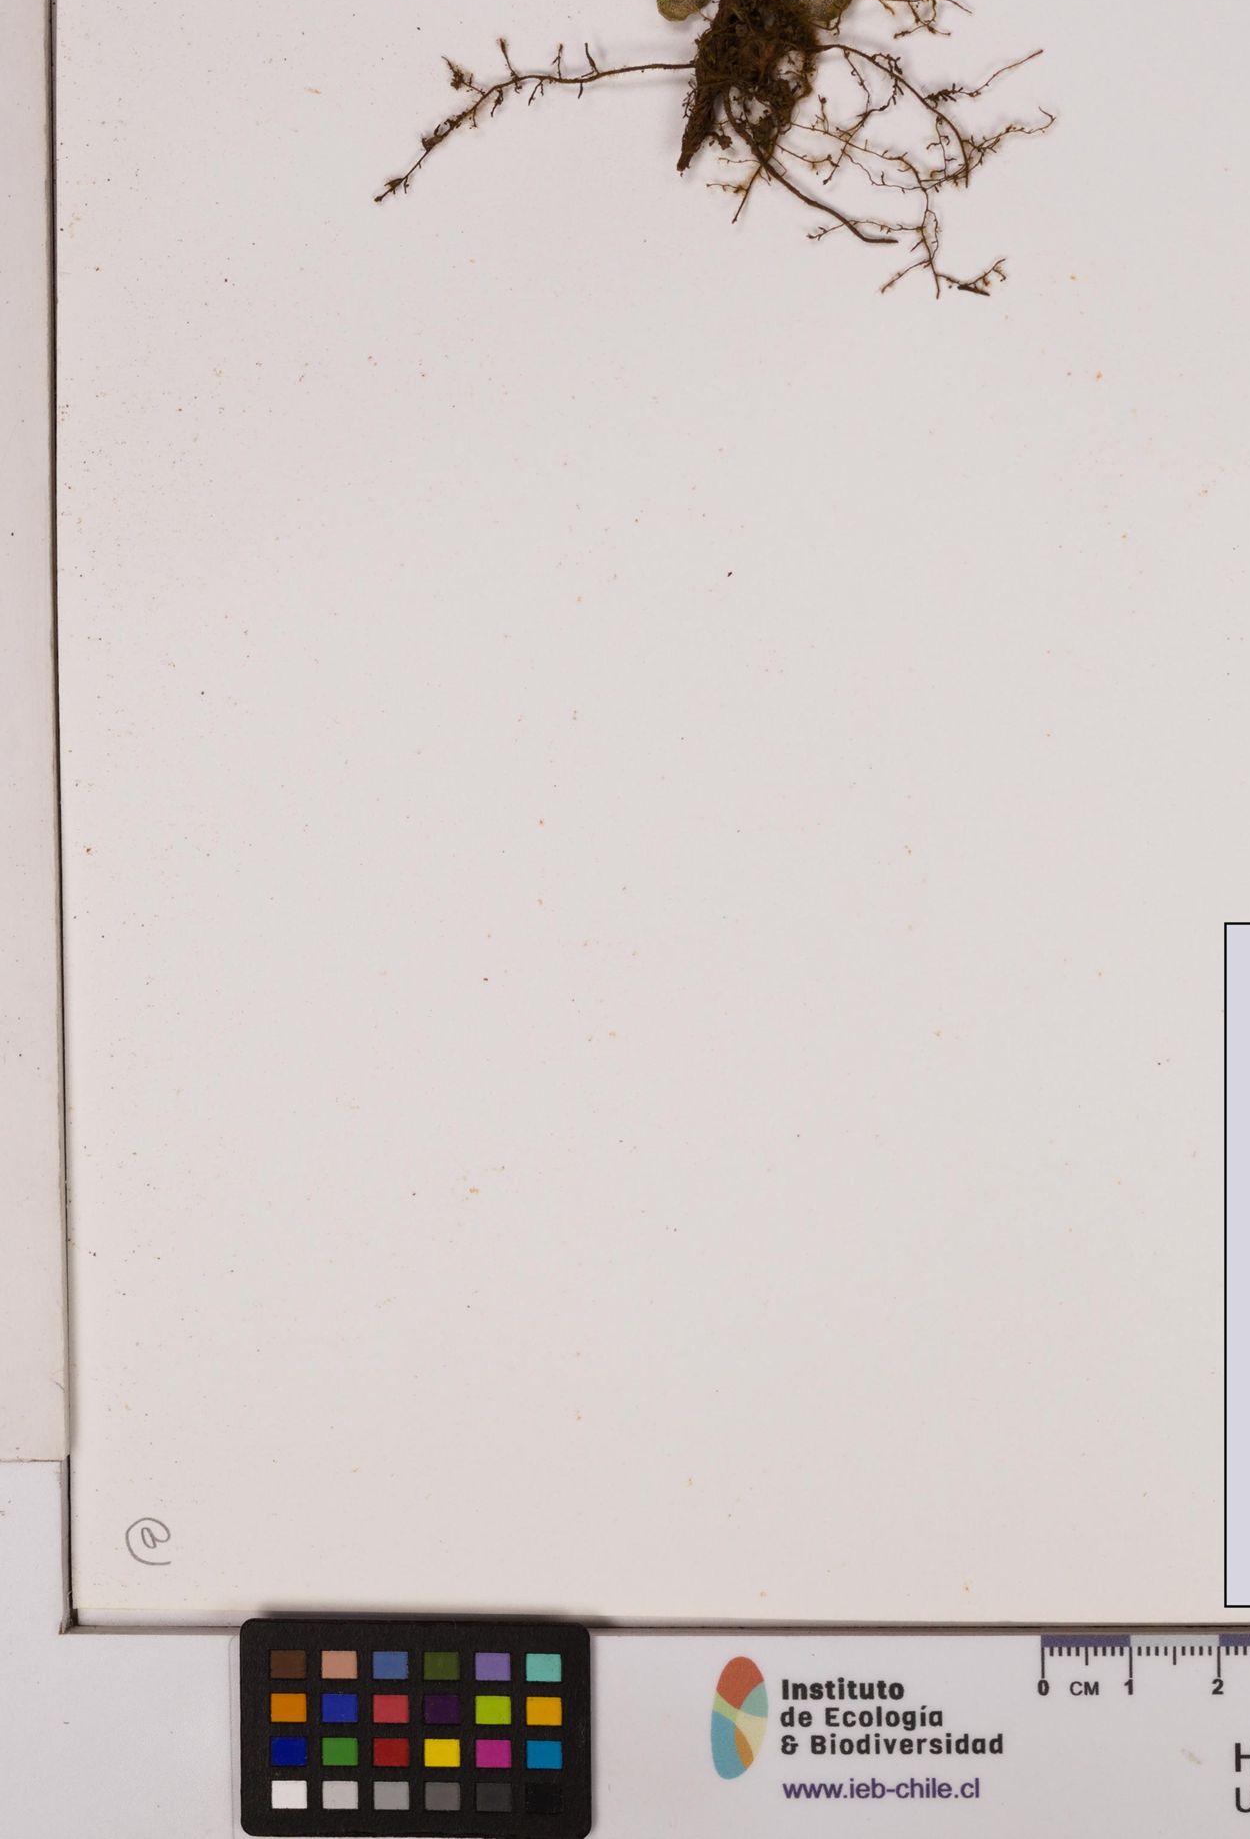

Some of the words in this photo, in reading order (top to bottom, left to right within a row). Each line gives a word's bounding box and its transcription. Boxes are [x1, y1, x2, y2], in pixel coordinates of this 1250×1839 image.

[781, 1676, 905, 1701] Instituto
[1037, 1679, 1050, 1697] 0
[1069, 1680, 1100, 1697] CM
[1123, 1678, 1134, 1696] 1
[1211, 1677, 1225, 1696] 2
[779, 1705, 813, 1728] de
[824, 1704, 943, 1732] Ecología
[780, 1734, 800, 1756] &
[810, 1732, 1004, 1756] Biodiversidad
[782, 1777, 980, 1800] www.ieb-chile.cl
